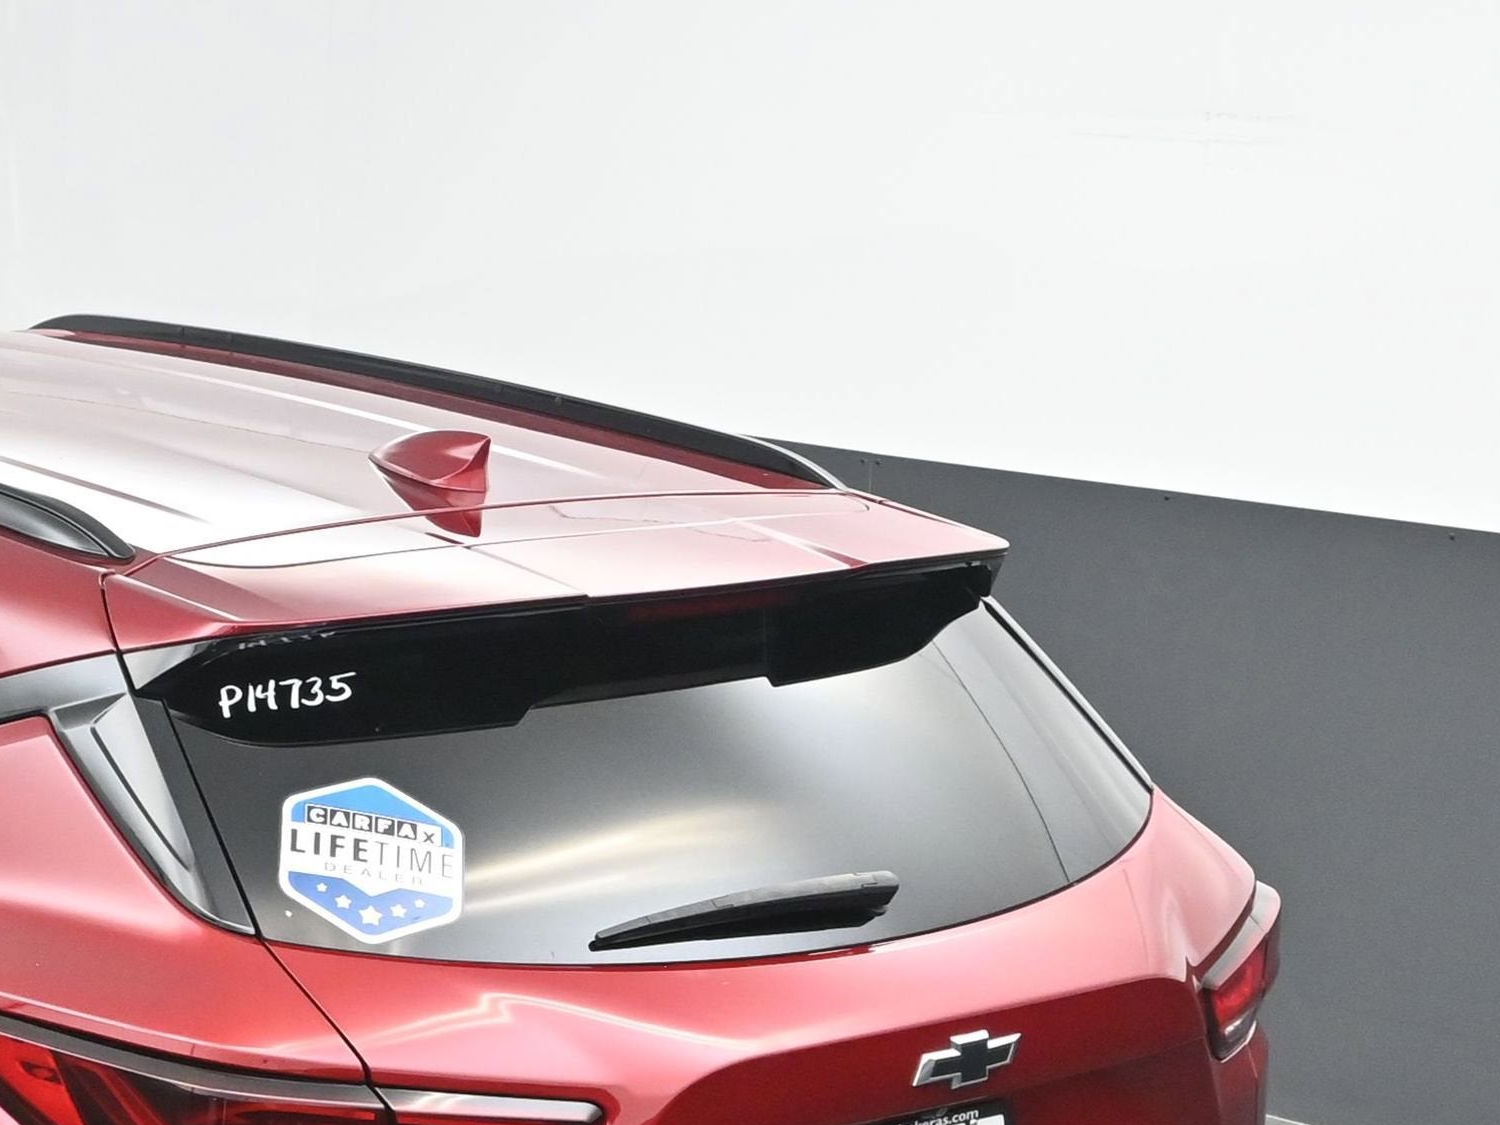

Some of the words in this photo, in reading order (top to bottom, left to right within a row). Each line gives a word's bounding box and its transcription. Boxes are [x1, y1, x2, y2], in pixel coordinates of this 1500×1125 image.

[218, 672, 357, 719] P14735
[306, 805, 438, 845] CARFAX
[290, 828, 454, 880] LIFETIME
[323, 860, 424, 886] DEALER
